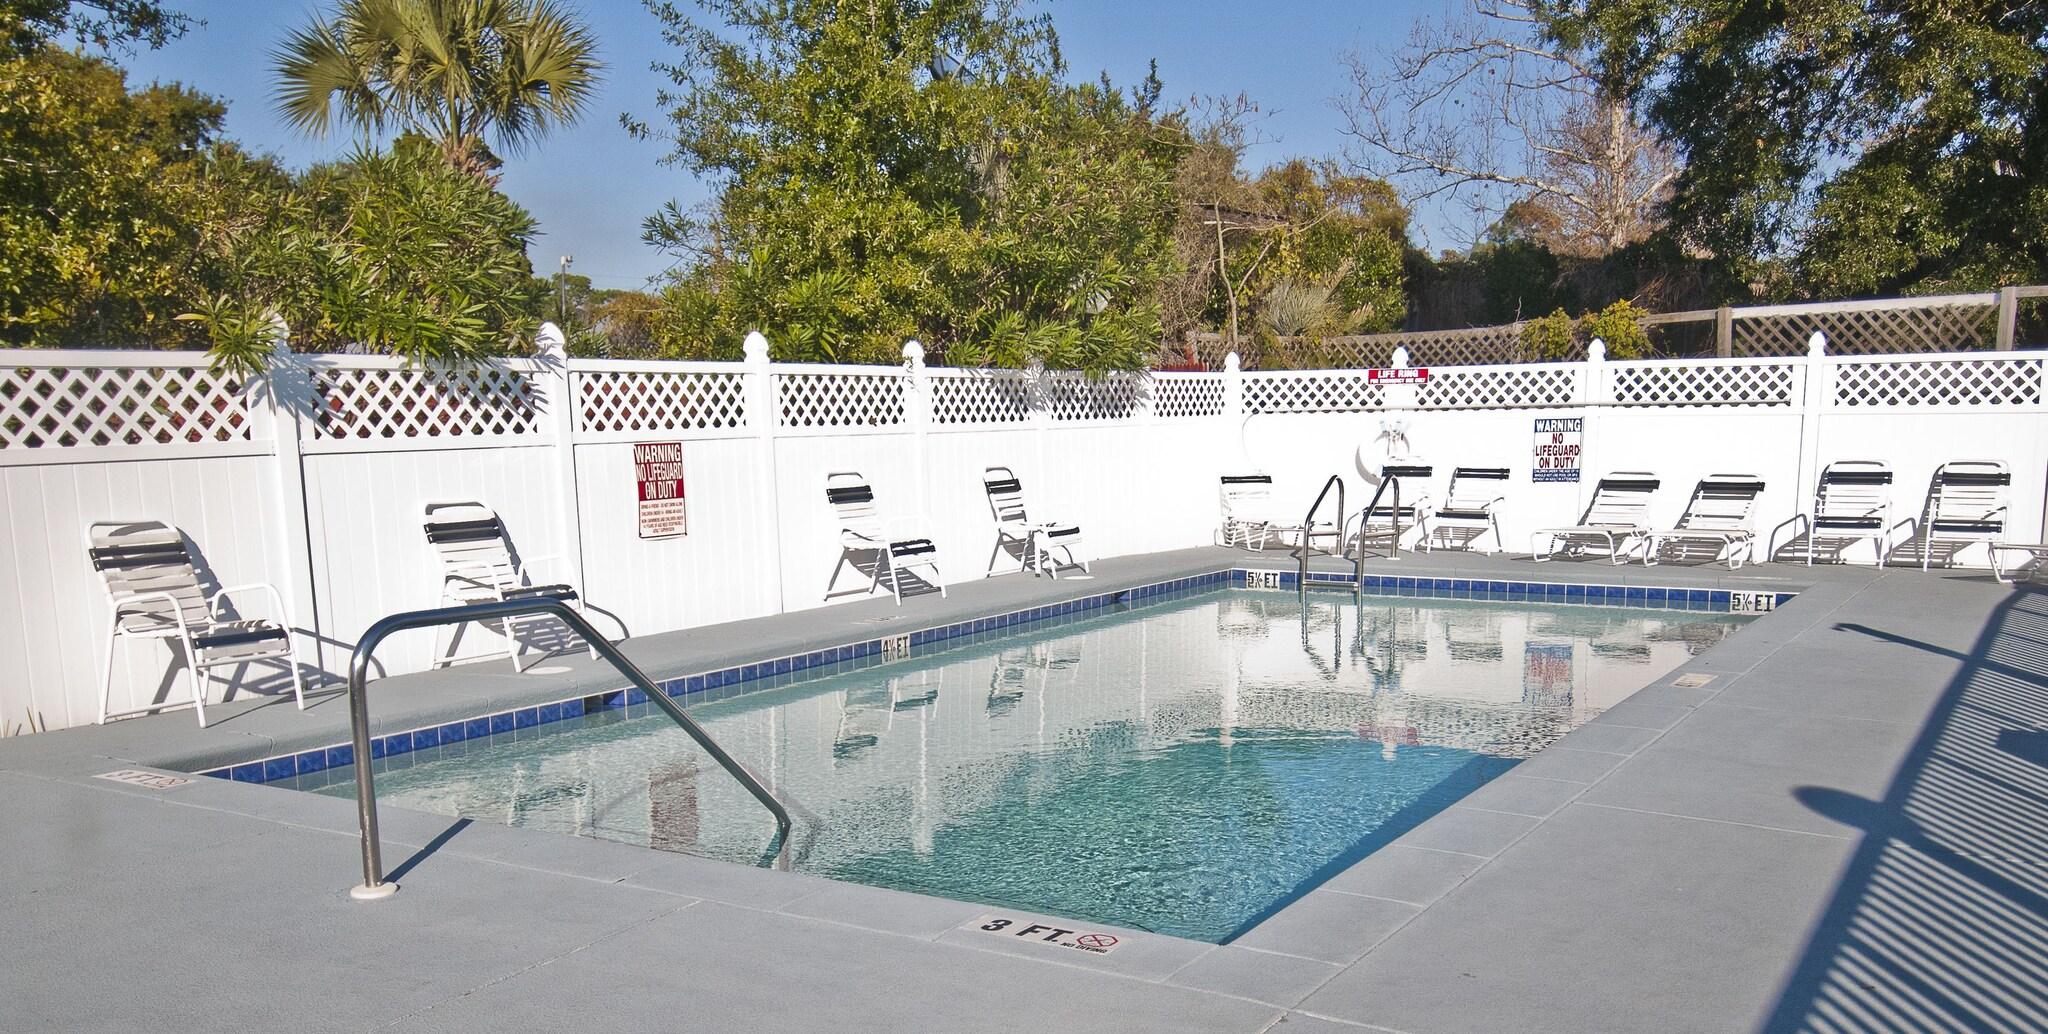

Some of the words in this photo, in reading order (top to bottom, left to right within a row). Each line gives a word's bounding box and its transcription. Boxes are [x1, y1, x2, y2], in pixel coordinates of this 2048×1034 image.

[1378, 369, 1396, 378] LIFE
[1398, 369, 1419, 378] RING
[1536, 419, 1581, 432] WARNING
[1552, 433, 1564, 444] NO
[633, 444, 682, 463] WARNING
[1535, 445, 1580, 456] LIFEGUARD
[1539, 457, 1550, 468] ON
[1554, 457, 1575, 468] DUTY
[635, 464, 647, 482] NO
[647, 462, 683, 481] LIFEGUARD
[645, 481, 657, 499] ON
[658, 480, 677, 498] DUTY
[981, 919, 1013, 931] 3
[1015, 924, 1074, 943] FT.
